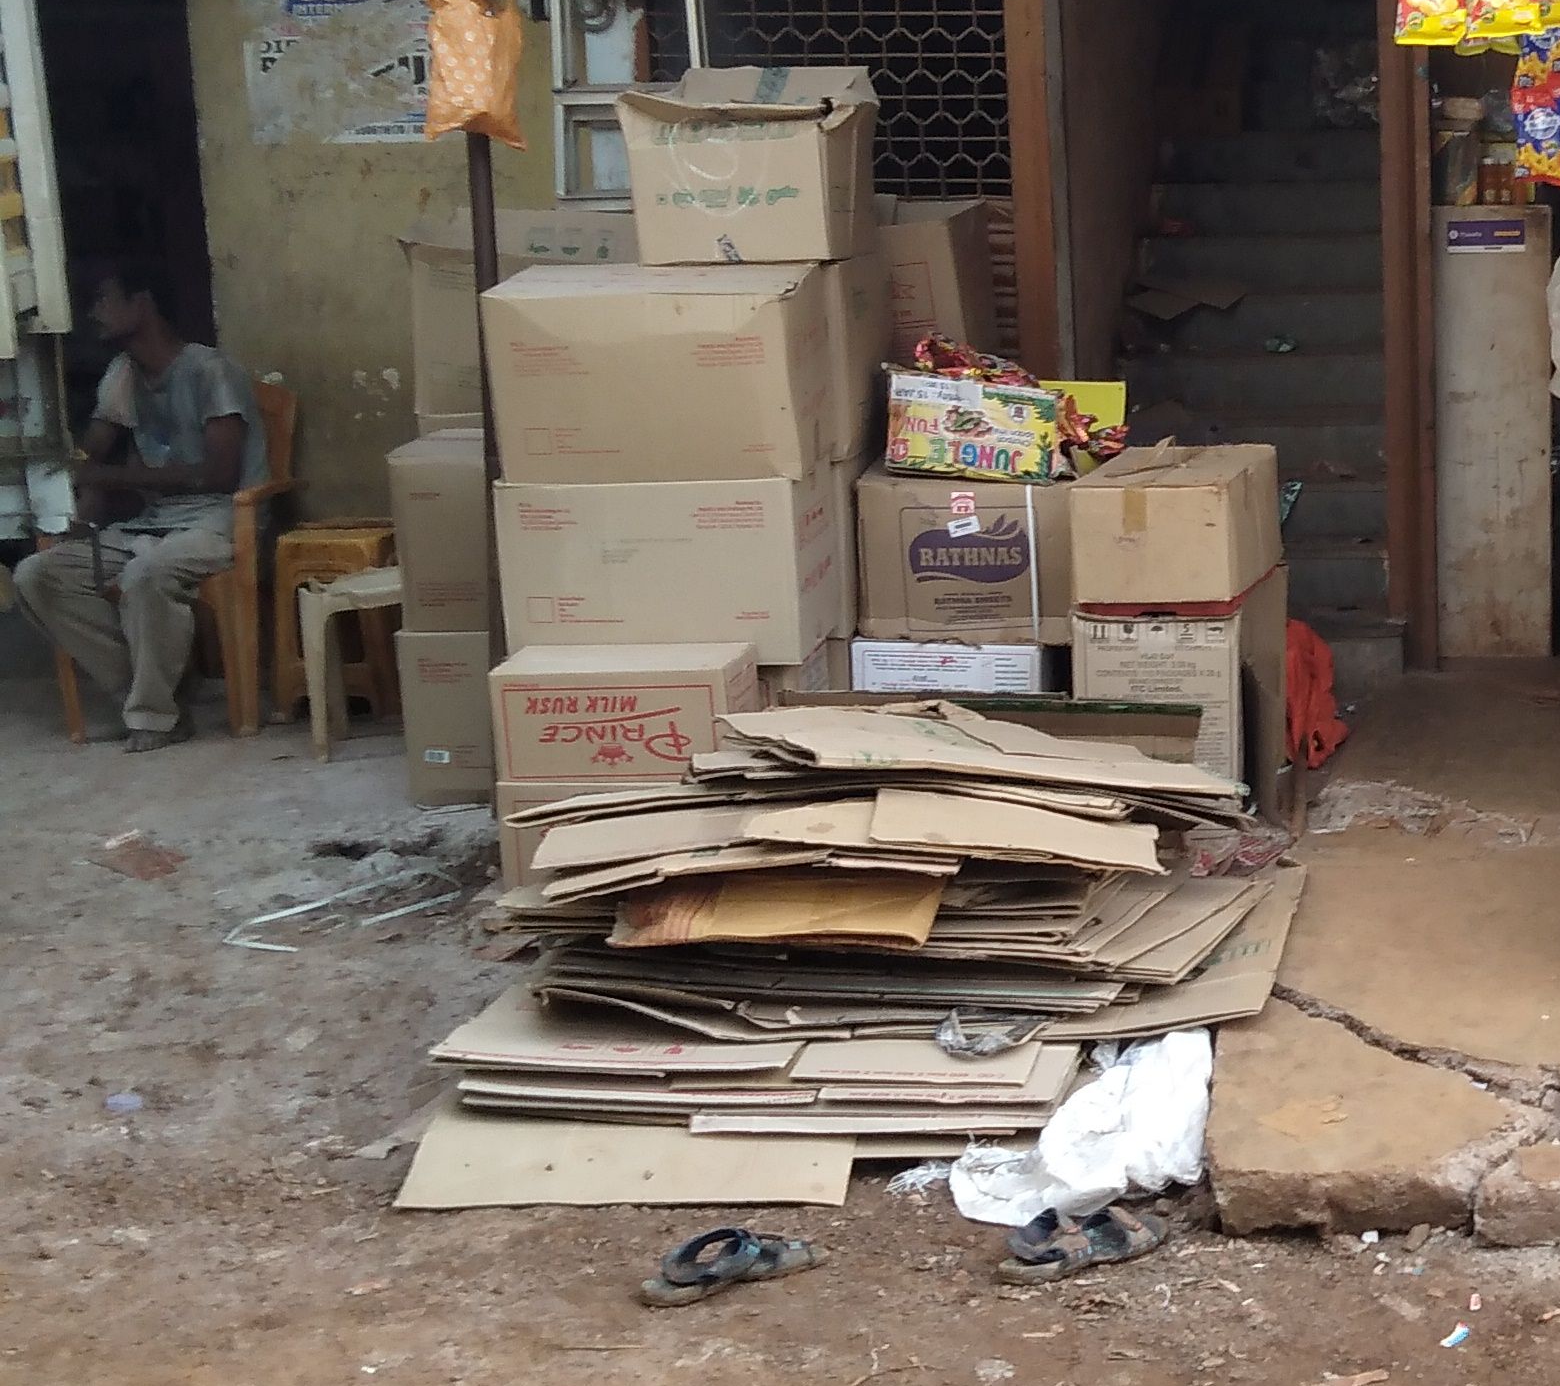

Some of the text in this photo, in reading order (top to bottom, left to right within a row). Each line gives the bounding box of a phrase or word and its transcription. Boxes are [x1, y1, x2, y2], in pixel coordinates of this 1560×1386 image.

[906, 416, 941, 436] FUN
[926, 437, 1023, 476] JUNGLE
[918, 546, 1022, 567] RATHNAS
[524, 694, 638, 716] MILK RUSK
[538, 720, 692, 762] PRINCE
